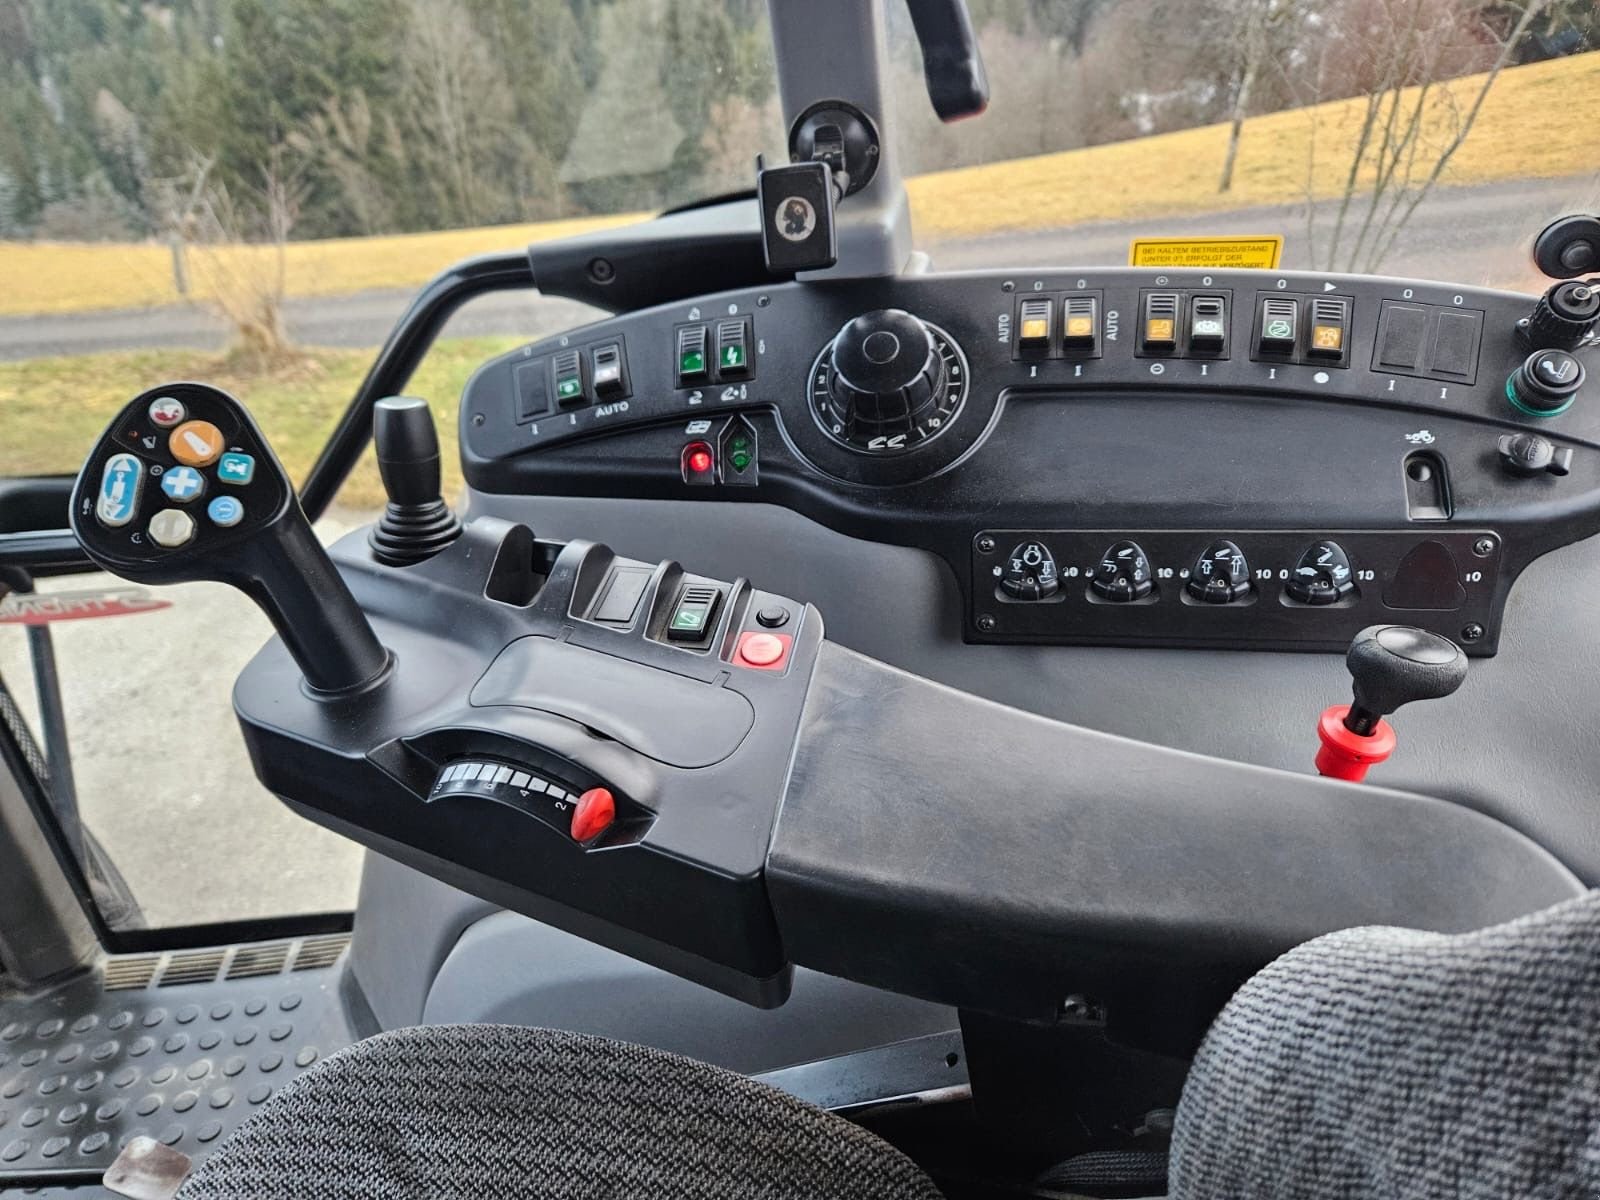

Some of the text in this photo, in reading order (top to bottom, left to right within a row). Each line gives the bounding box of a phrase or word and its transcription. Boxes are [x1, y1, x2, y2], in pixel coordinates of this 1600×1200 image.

[998, 313, 1010, 343] AUTO
[1106, 310, 1119, 340] AUTO
[818, 375, 826, 384] 2
[595, 401, 629, 418] AUTO
[927, 418, 941, 427] 10
[1255, 569, 1272, 579] 10
[1357, 570, 1375, 580] 10
[554, 801, 567, 811] 2
